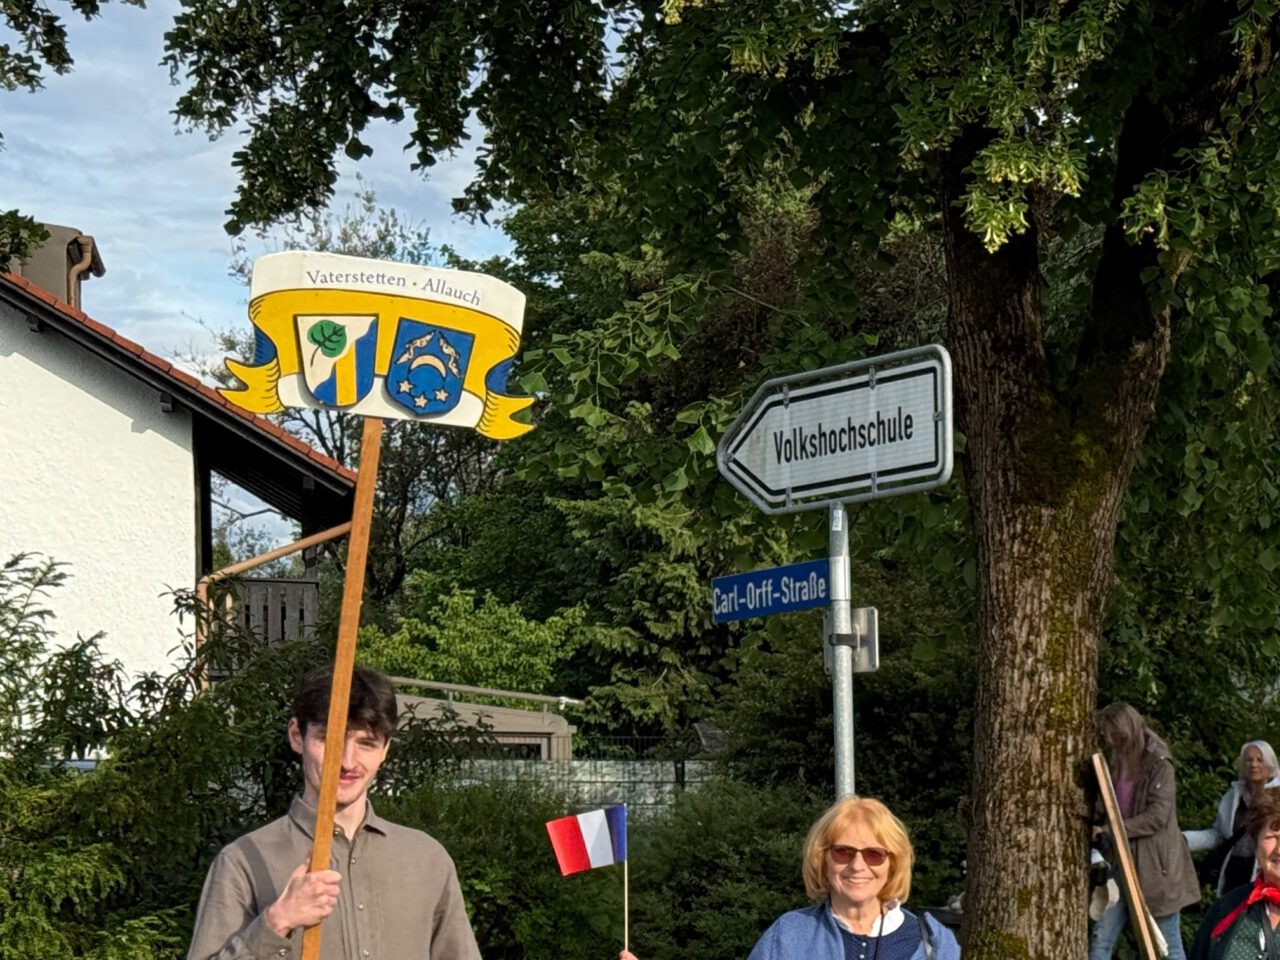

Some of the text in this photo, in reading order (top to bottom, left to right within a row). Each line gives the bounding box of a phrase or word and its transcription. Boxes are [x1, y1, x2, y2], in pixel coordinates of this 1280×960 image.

[306, 270, 481, 306] Vaterstetten Allauch
[773, 406, 914, 465] Volkshochschule
[713, 571, 826, 615] Carl-Orff-Straße
